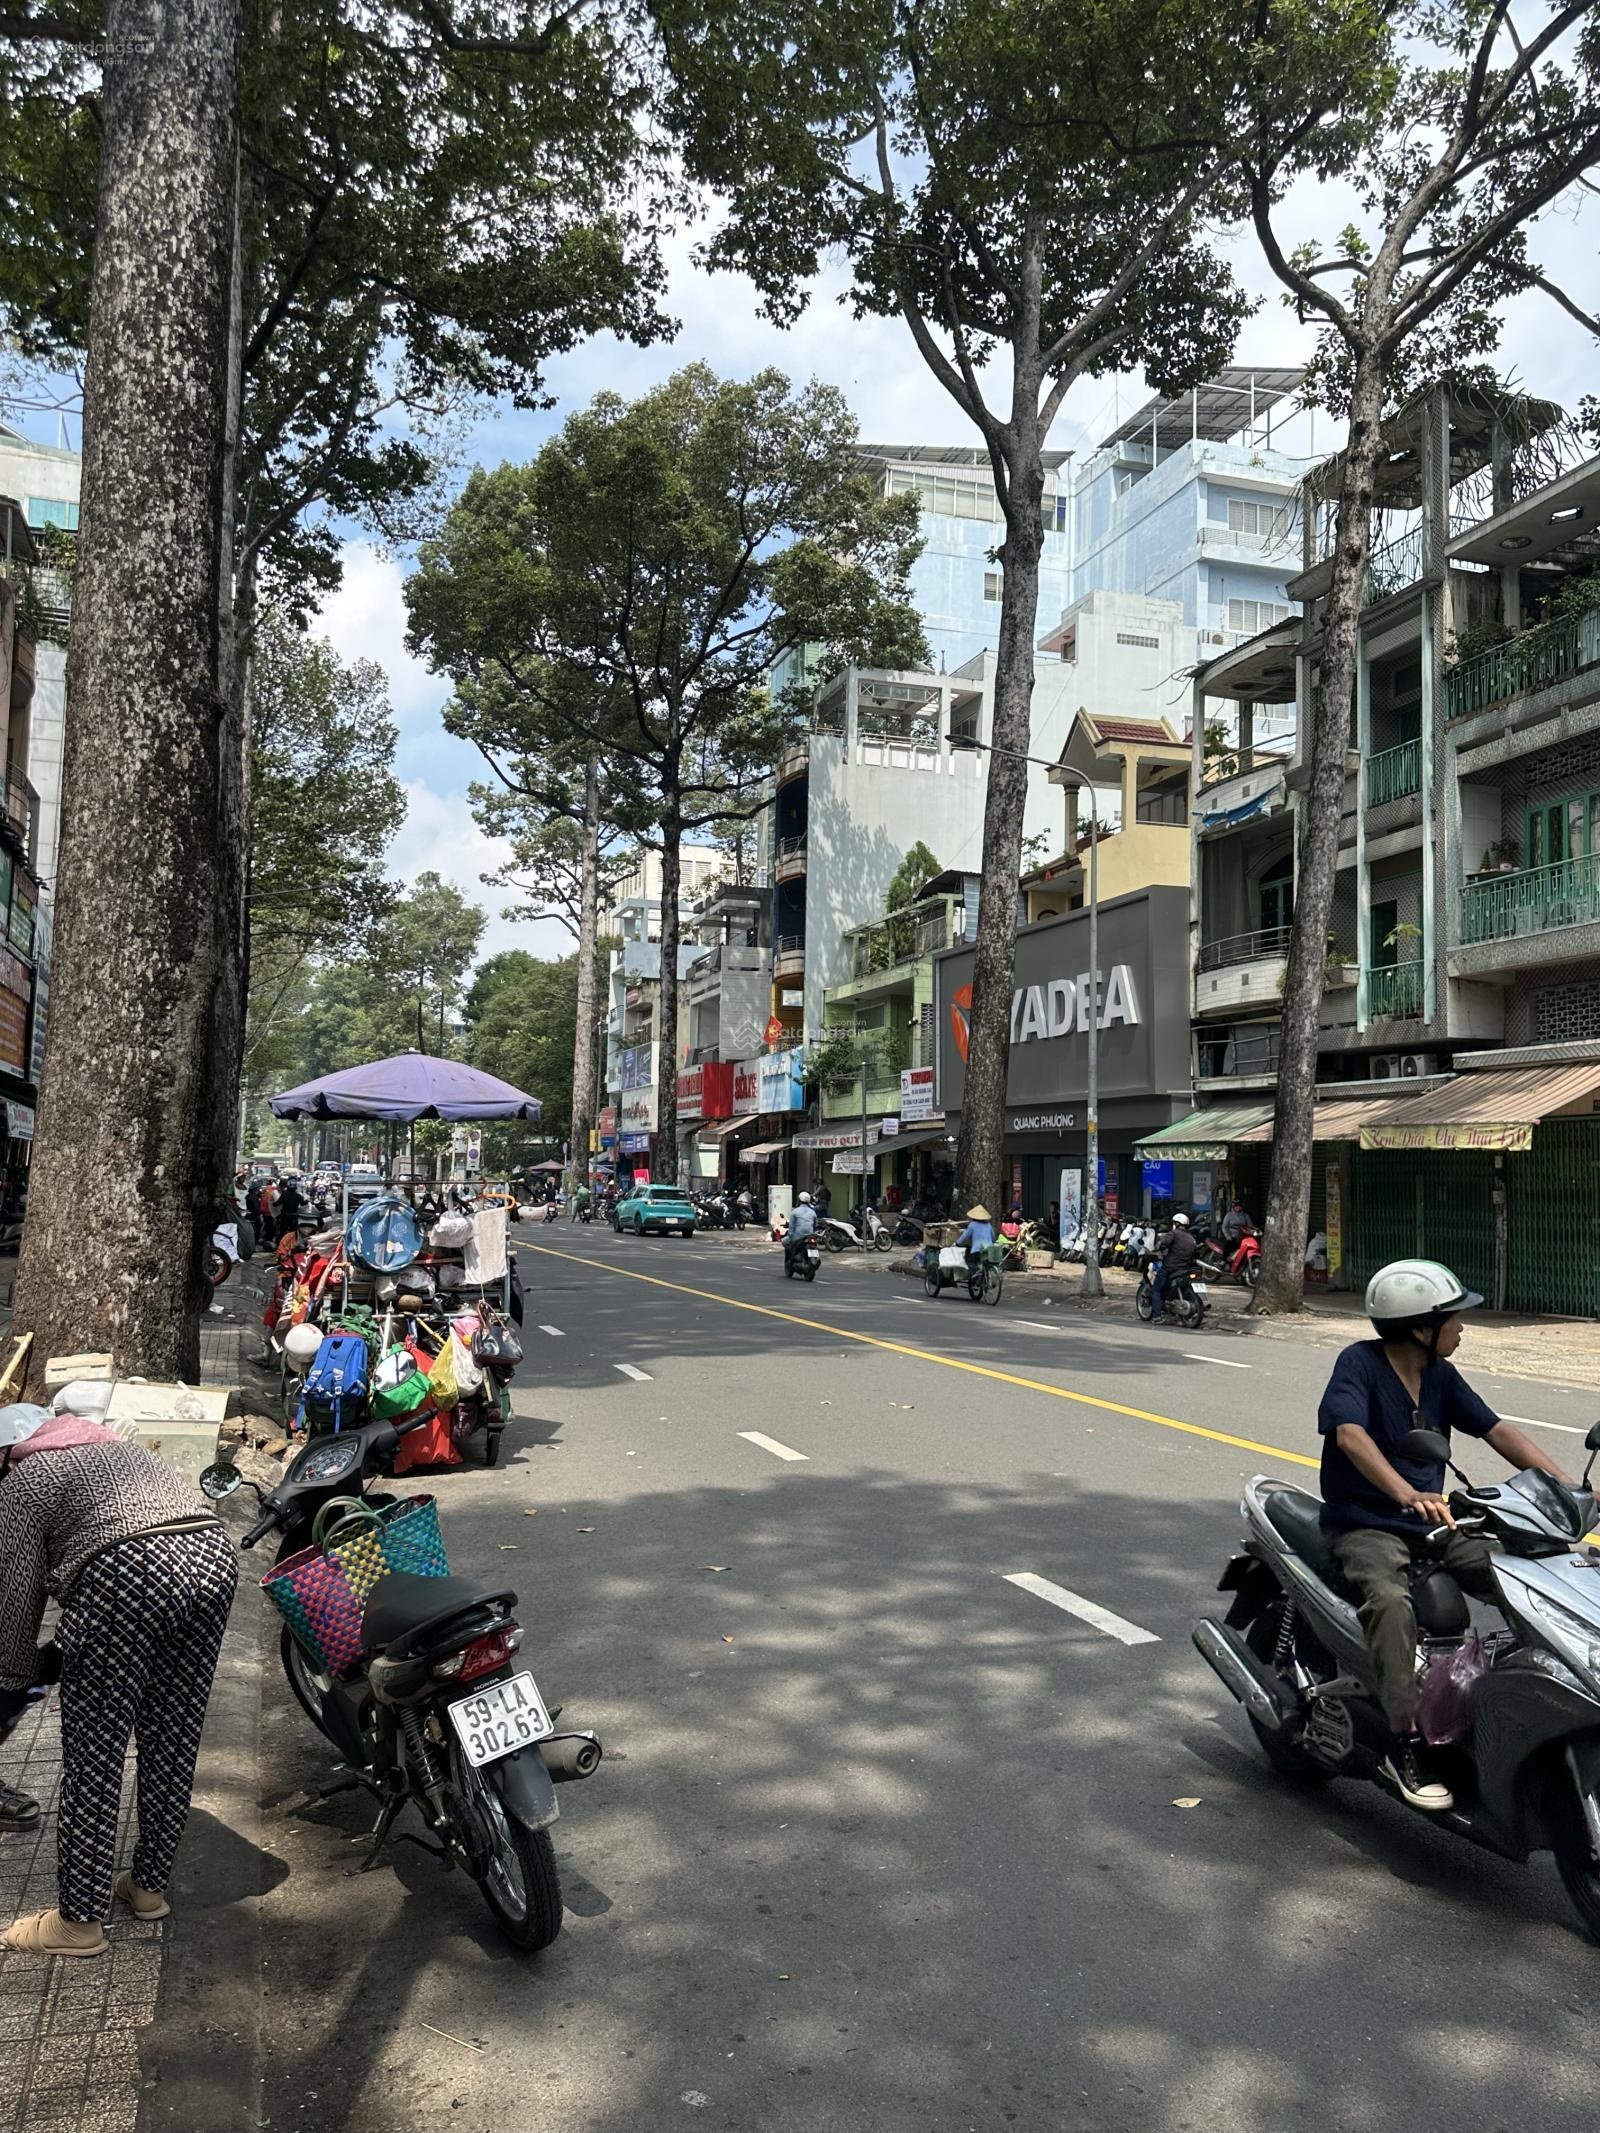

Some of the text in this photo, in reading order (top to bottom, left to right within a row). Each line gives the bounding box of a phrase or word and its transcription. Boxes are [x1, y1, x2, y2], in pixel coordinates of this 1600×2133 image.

[1013, 1113, 1074, 1130] QUANG PHƯƠNG
[1371, 1129, 1395, 1146] Kem
[474, 1677, 501, 1692] HONDA
[463, 1682, 529, 1729] 59-LA
[469, 1707, 545, 1759] 302.63
